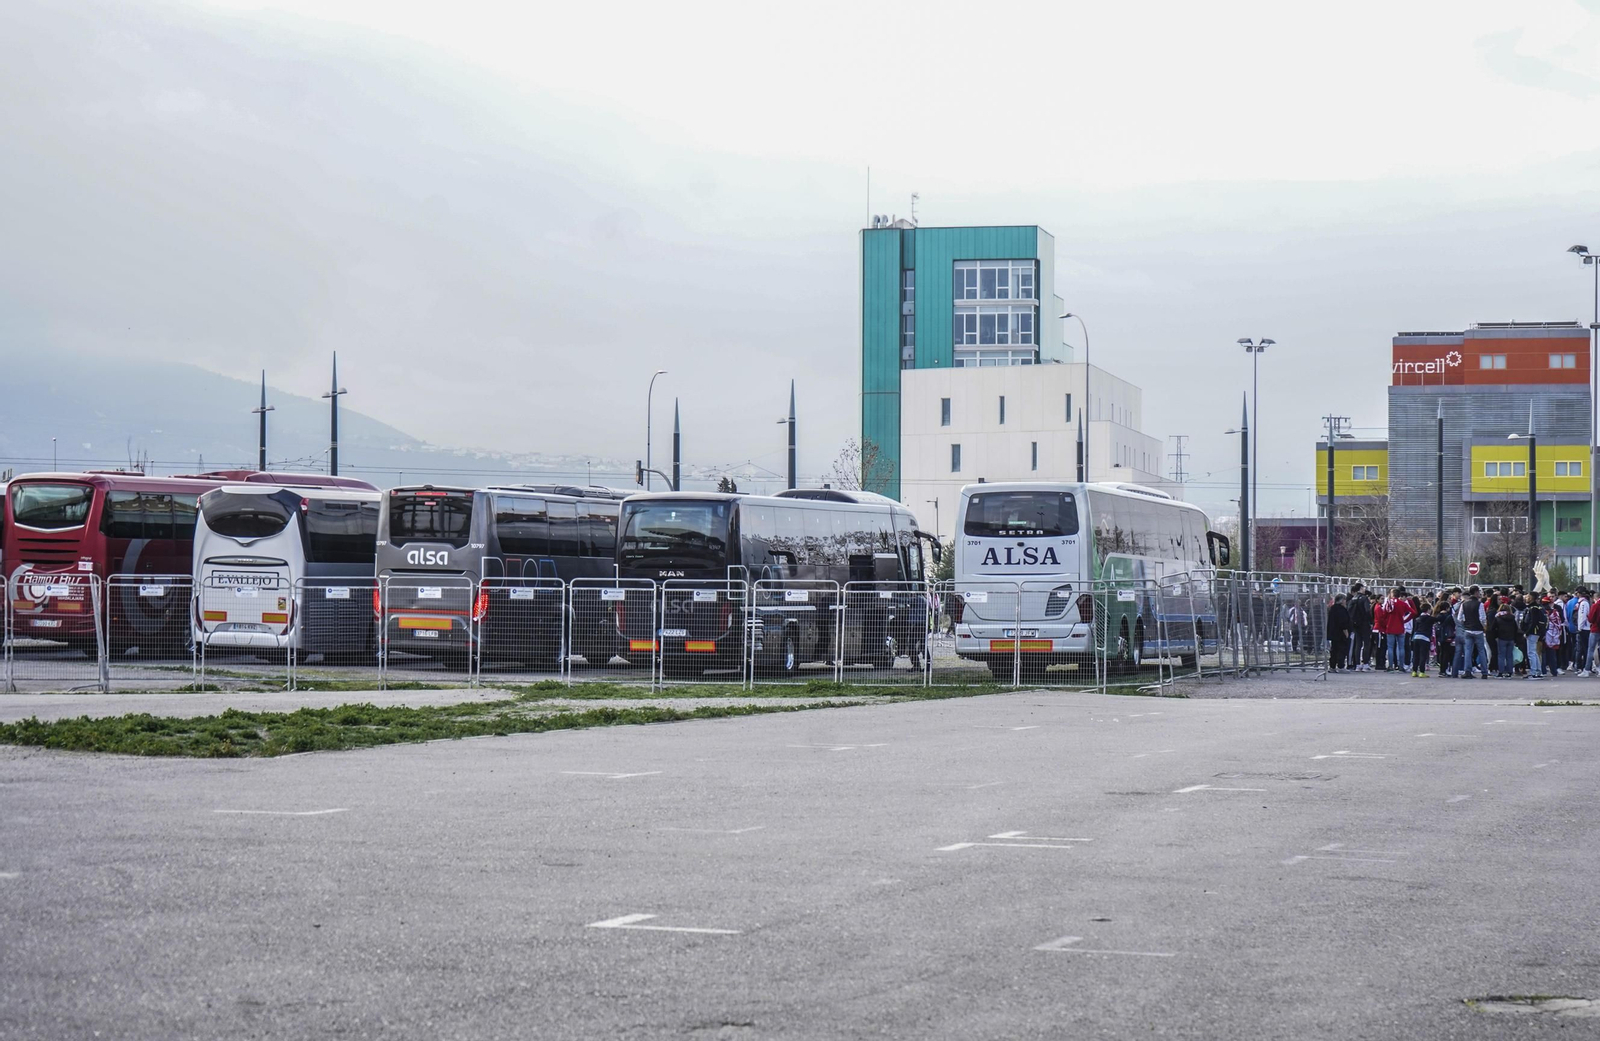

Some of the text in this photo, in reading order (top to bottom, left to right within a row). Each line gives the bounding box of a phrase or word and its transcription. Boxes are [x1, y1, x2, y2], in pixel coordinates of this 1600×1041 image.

[1392, 358, 1445, 374] vircell
[407, 548, 449, 565] alsa
[981, 547, 1061, 565] ALSA
[218, 574, 272, 586] E.VALLEJO
